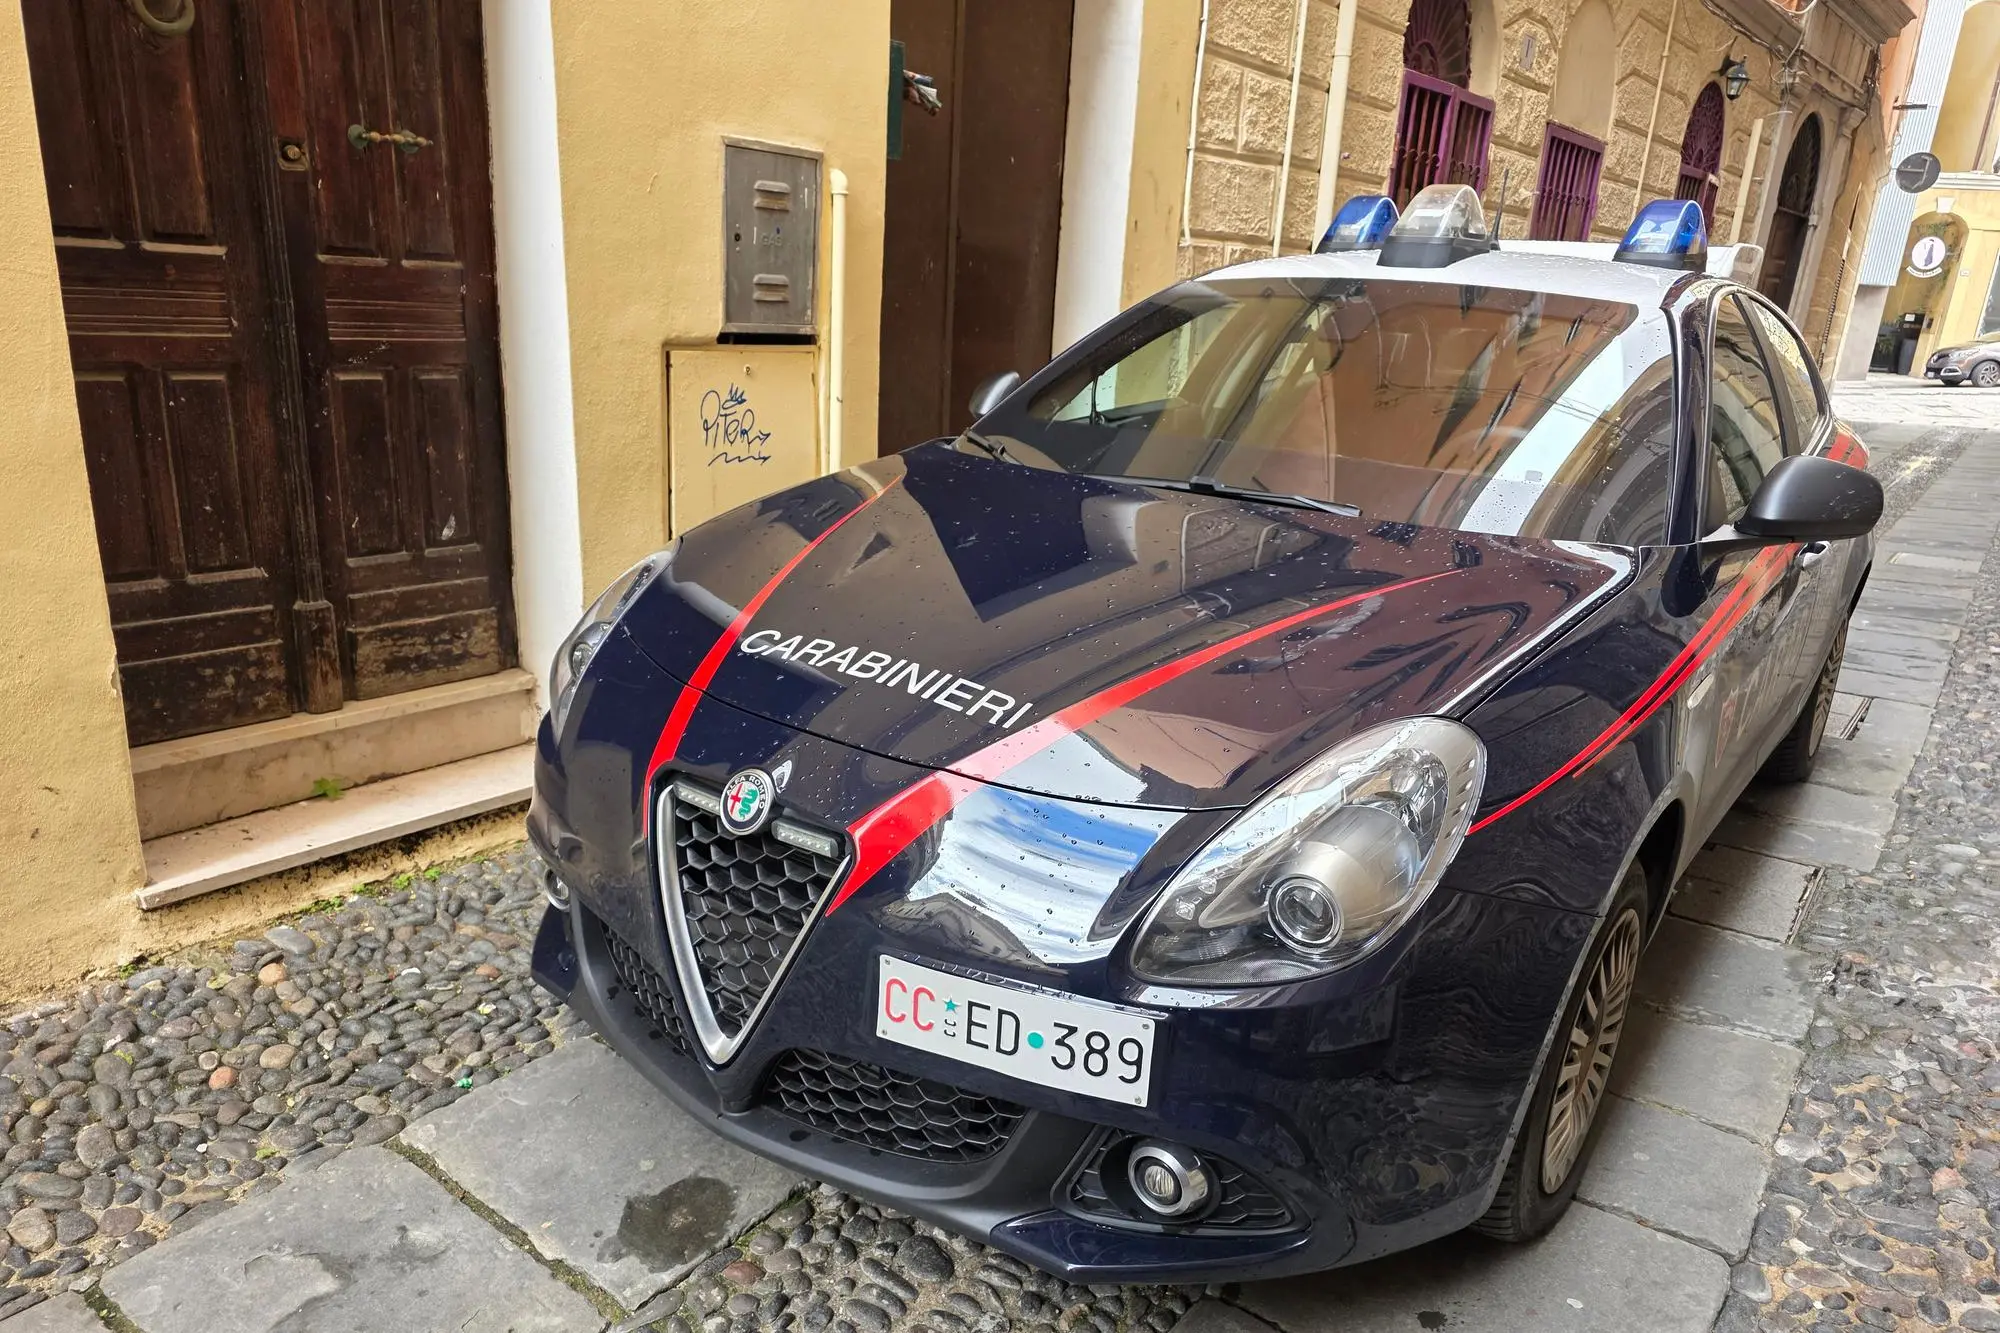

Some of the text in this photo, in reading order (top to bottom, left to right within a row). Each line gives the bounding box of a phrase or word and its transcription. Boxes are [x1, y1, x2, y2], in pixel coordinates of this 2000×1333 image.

[740, 629, 1034, 729] CARABINIERI
[726, 775, 766, 809] ALFA ROMEO
[884, 977, 1145, 1084] CC ED 389
